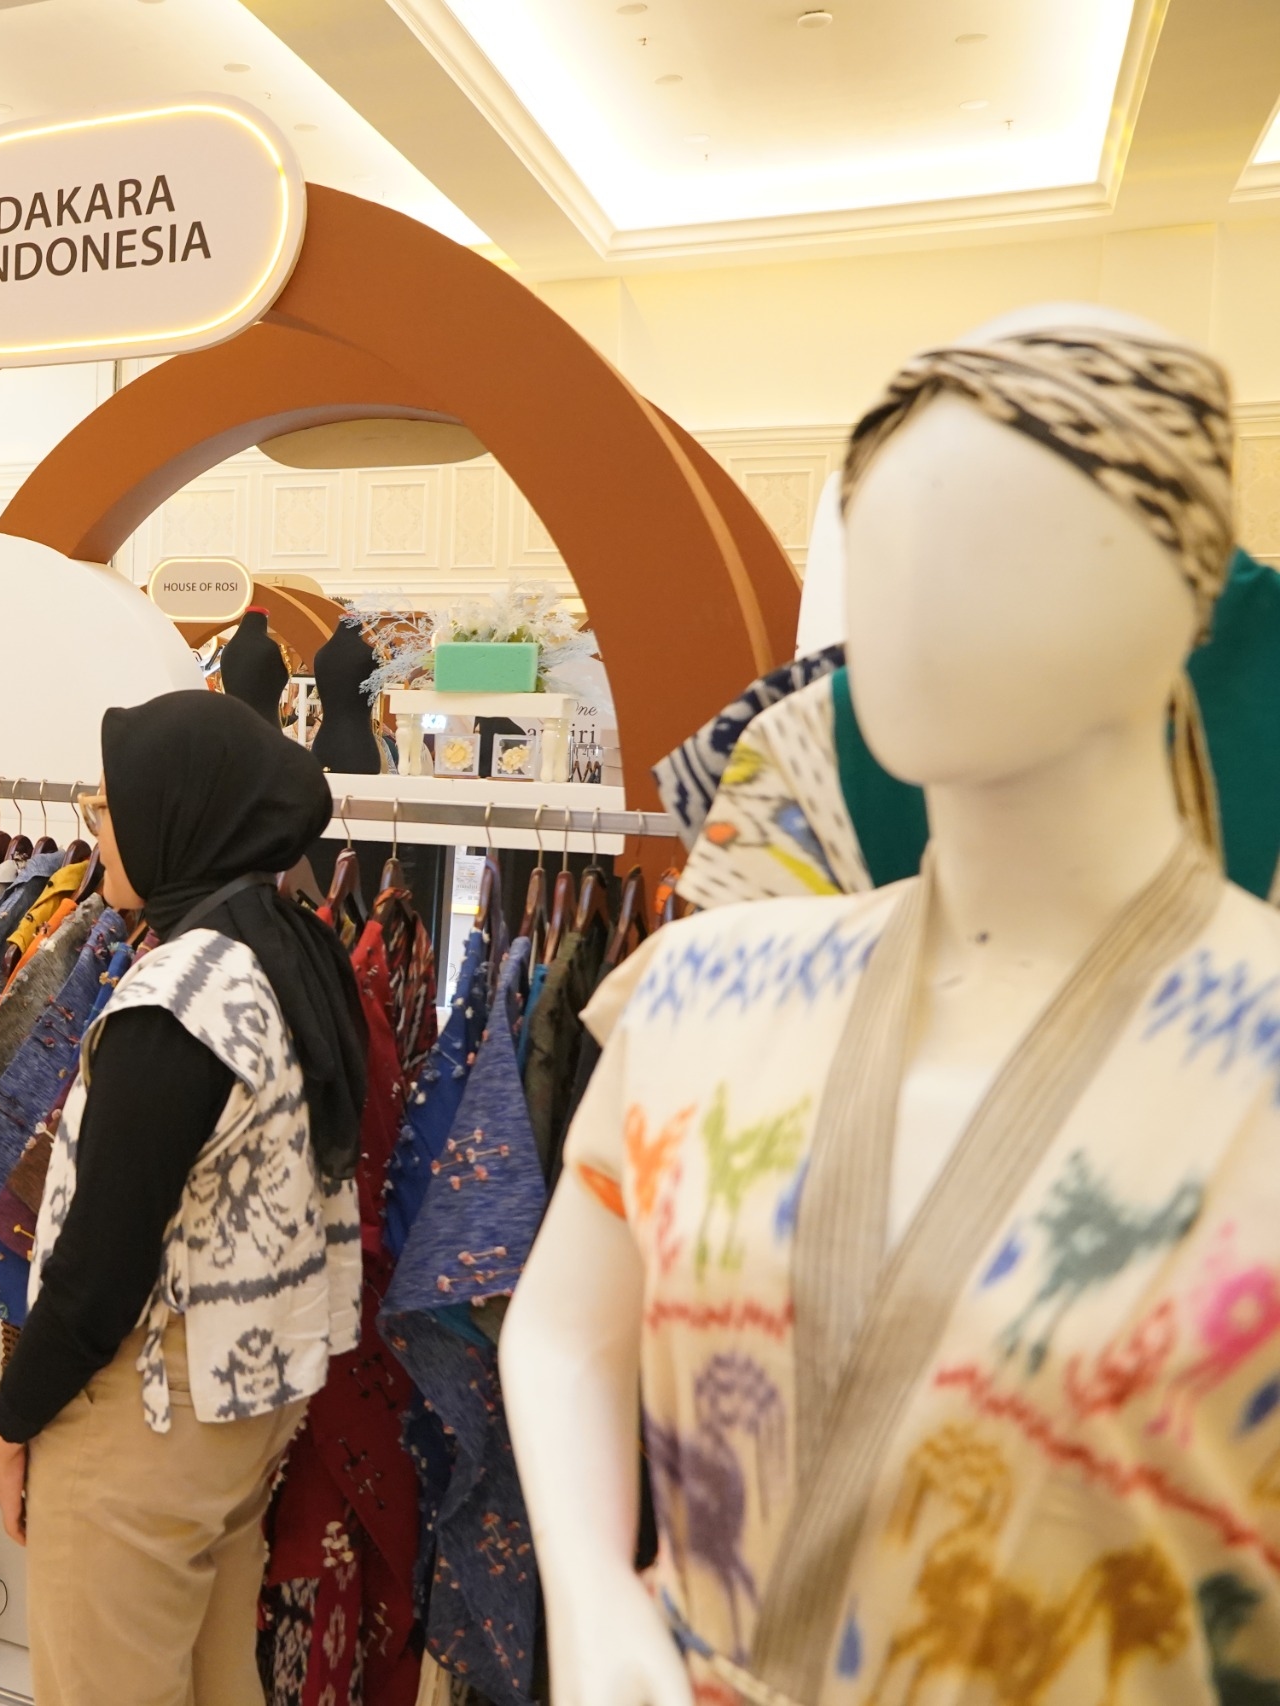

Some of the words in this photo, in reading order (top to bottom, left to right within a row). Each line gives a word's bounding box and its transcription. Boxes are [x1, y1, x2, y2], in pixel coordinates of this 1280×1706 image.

[163, 582, 197, 592] HOUSE
[199, 582, 212, 592] OF
[215, 582, 238, 592] ROSI
[576, 702, 598, 716] ne
